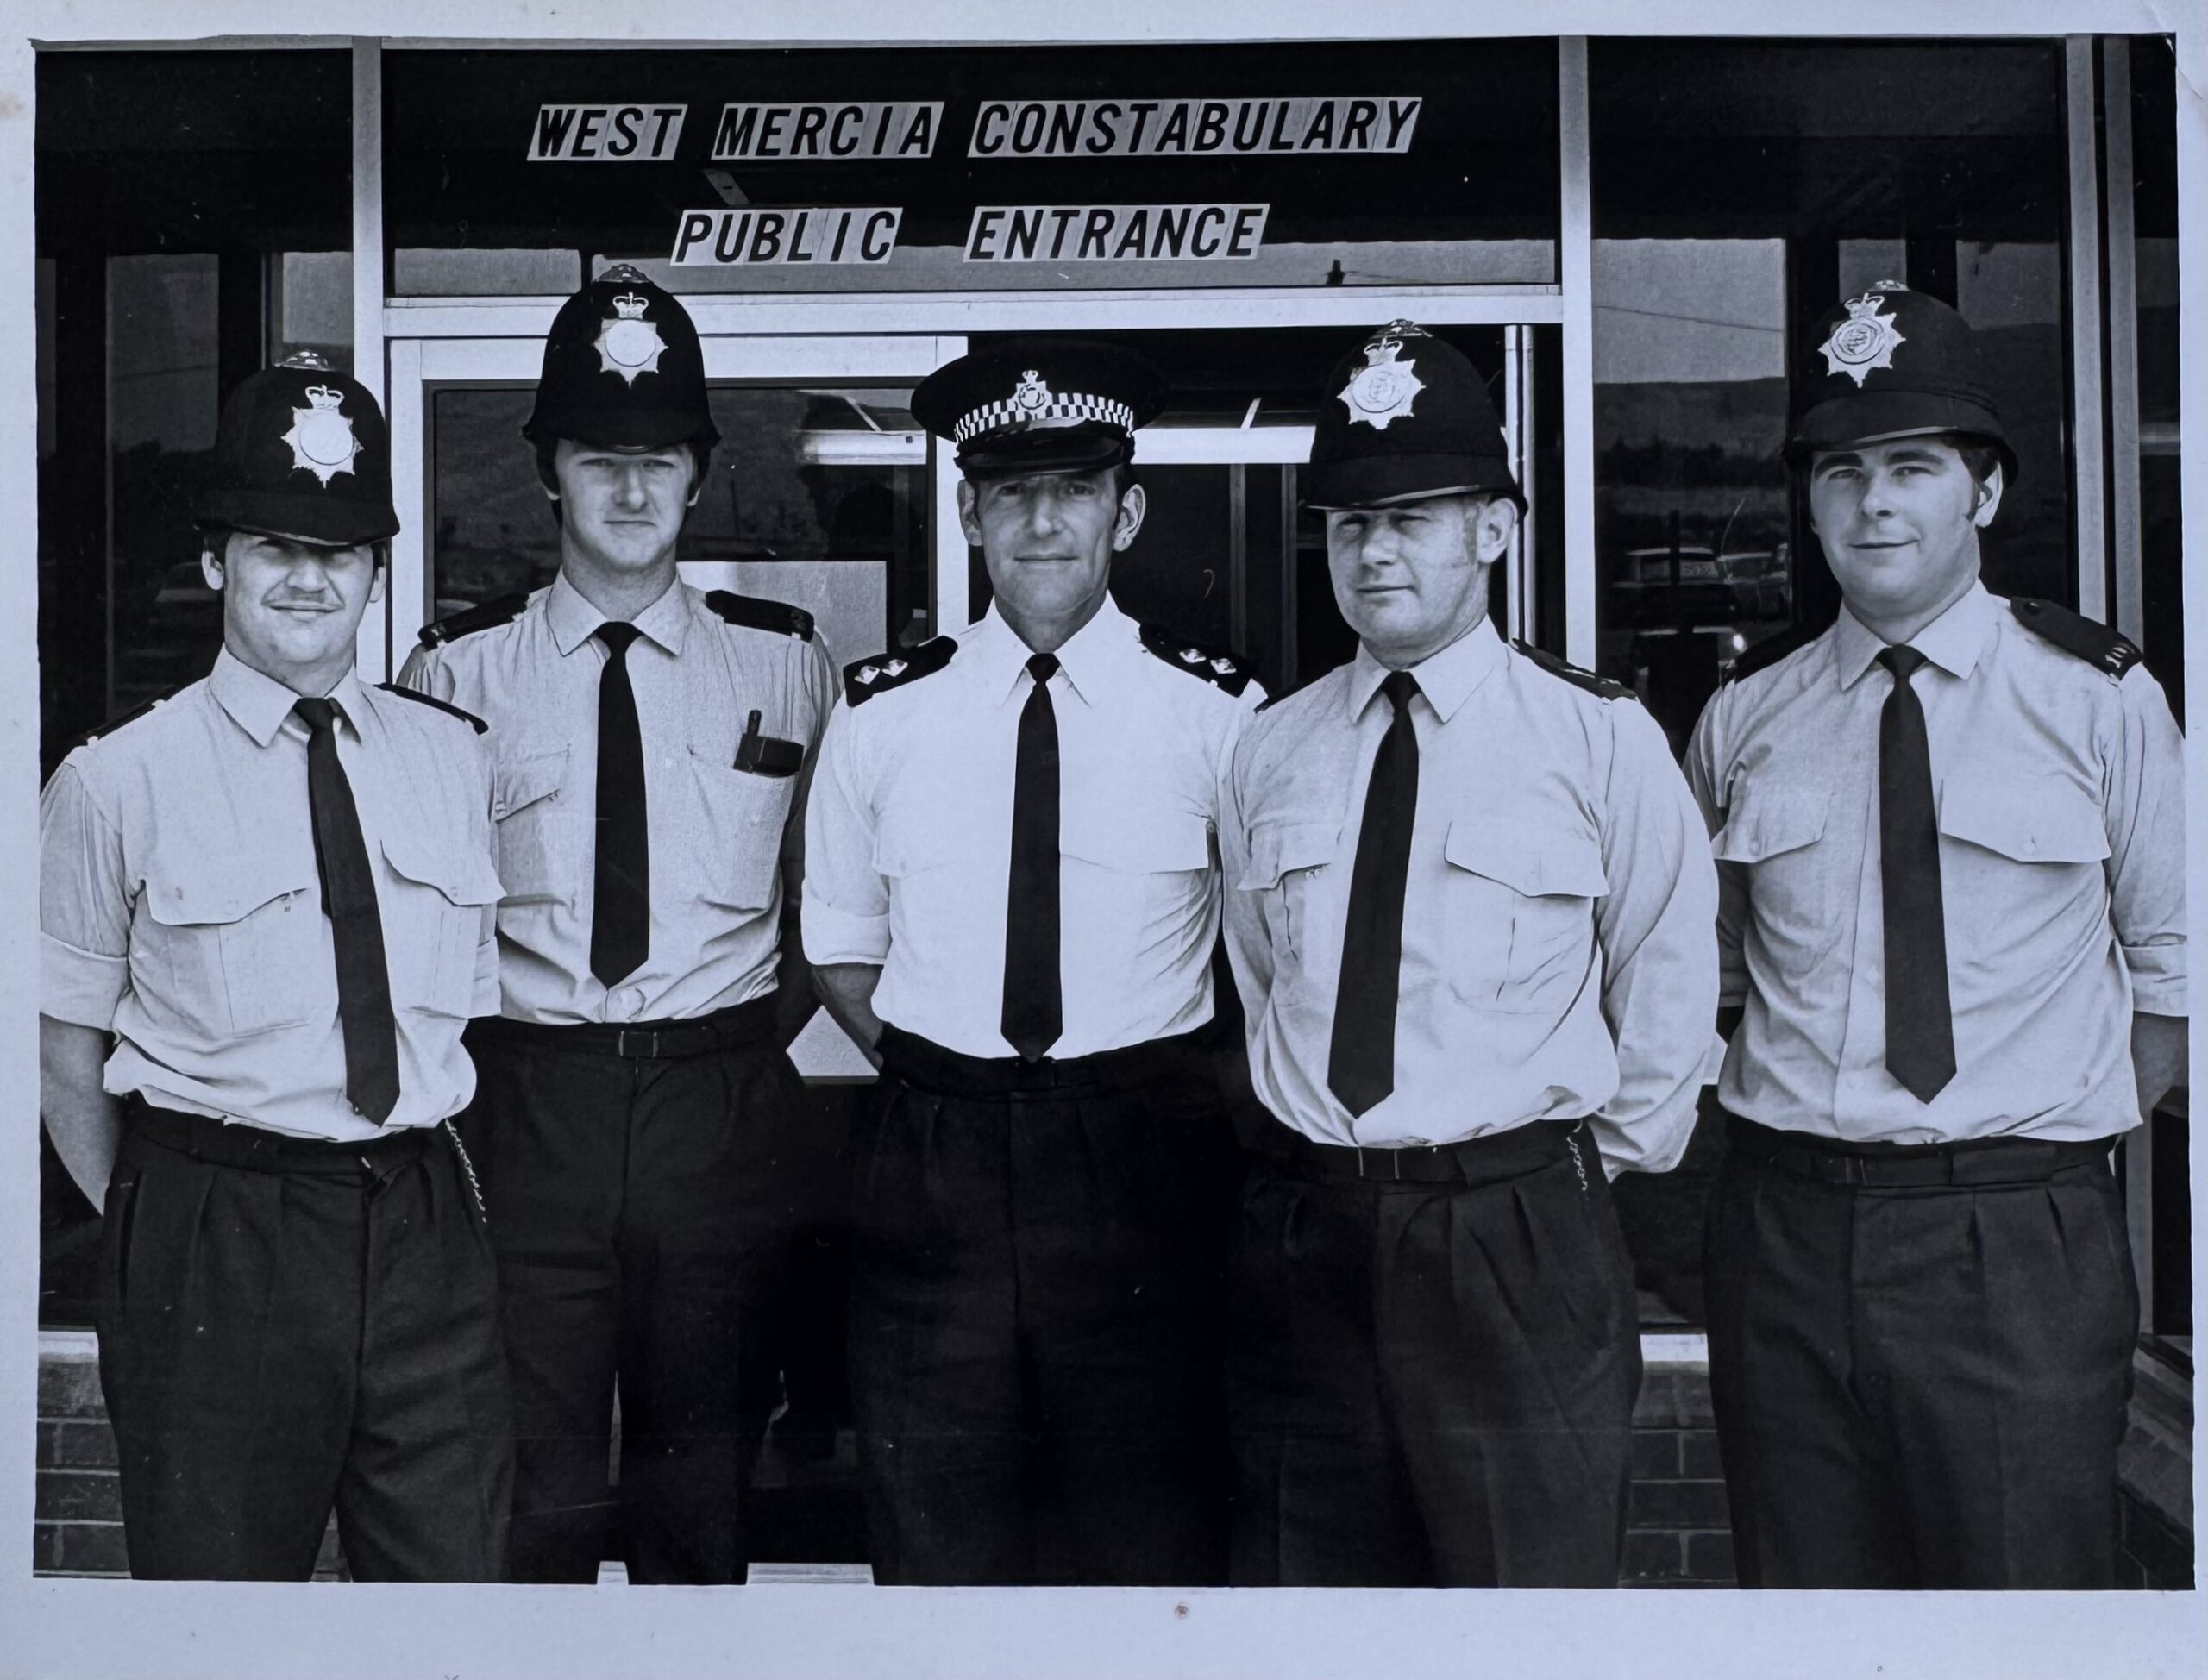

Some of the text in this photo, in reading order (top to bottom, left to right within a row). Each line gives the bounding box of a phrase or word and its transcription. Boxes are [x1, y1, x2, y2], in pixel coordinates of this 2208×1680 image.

[538, 100, 1419, 158] WEST MERCIA CONSTABULARY
[675, 207, 1263, 262] PUBLIC ENTRANCE
